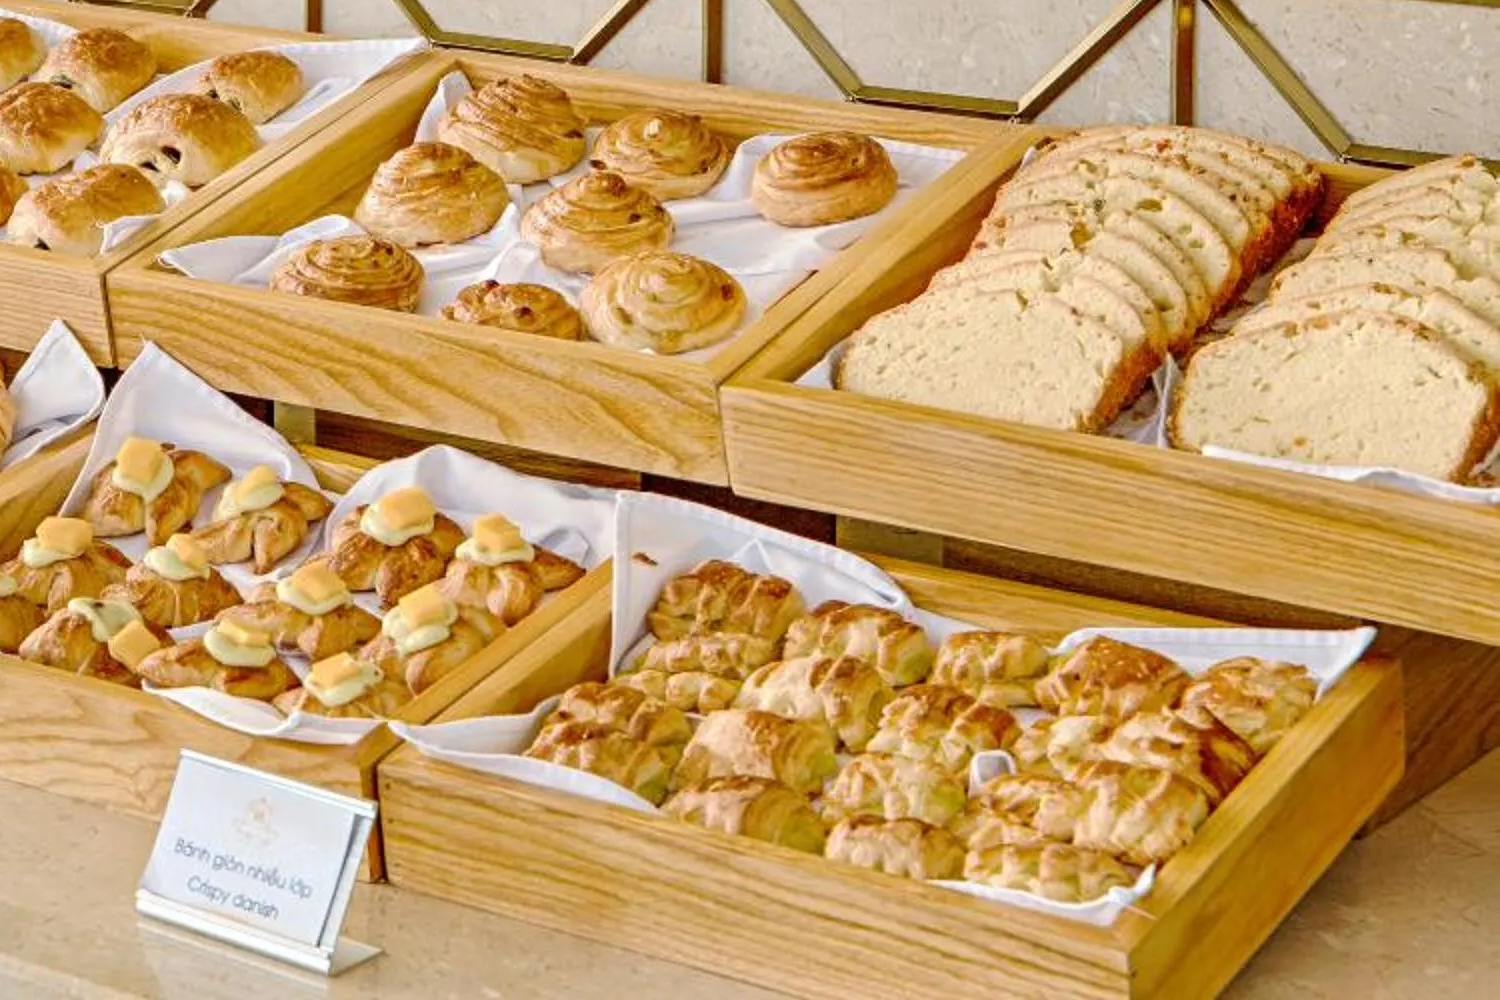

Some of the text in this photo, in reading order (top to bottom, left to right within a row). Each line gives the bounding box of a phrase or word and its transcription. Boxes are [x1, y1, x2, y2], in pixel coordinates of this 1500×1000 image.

[174, 837, 210, 862] Bánh
[186, 874, 278, 920] Crispy danish
